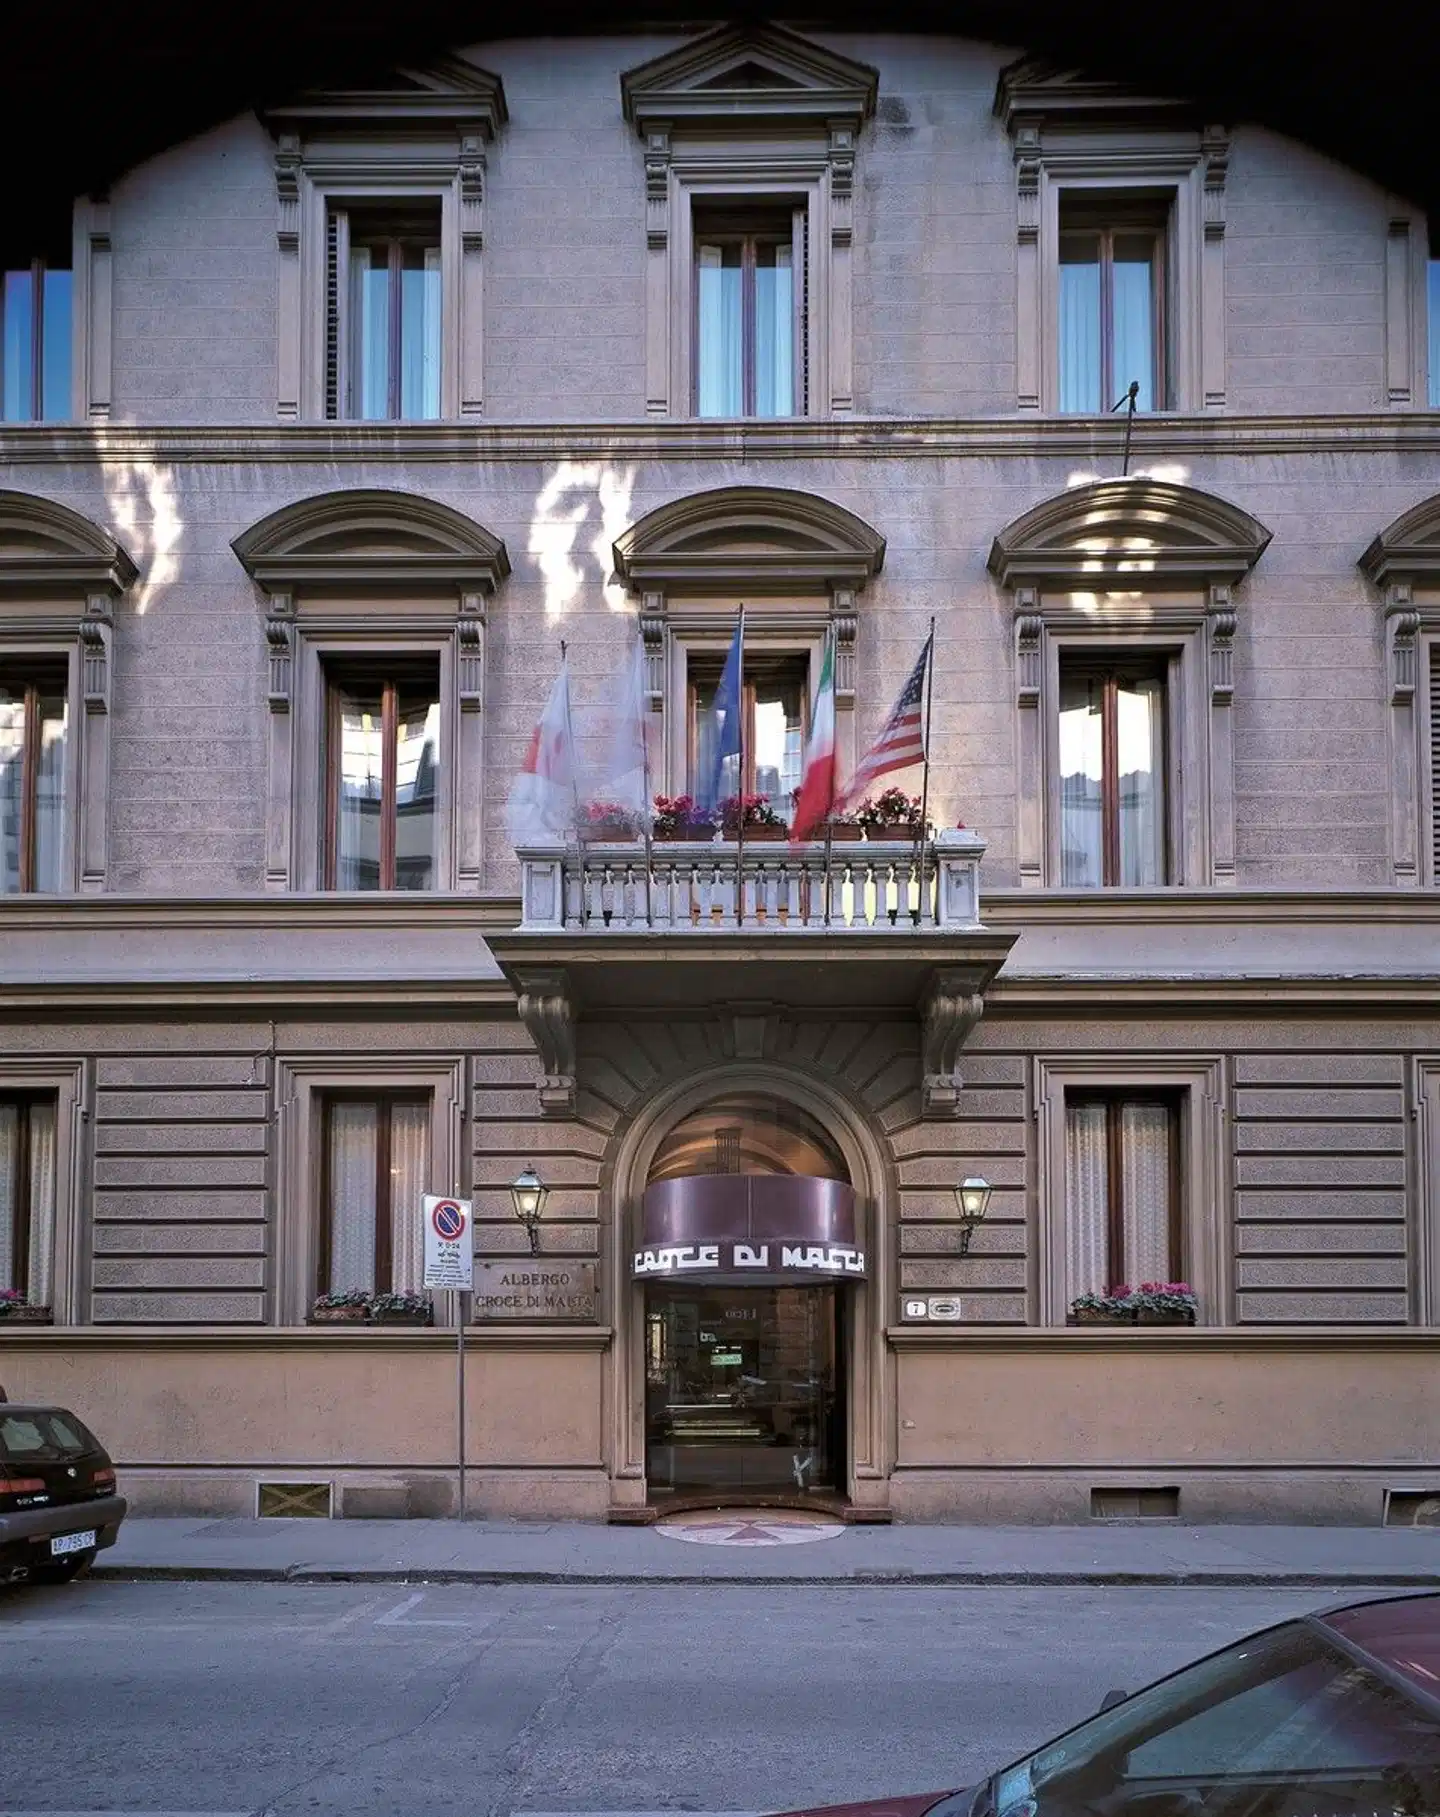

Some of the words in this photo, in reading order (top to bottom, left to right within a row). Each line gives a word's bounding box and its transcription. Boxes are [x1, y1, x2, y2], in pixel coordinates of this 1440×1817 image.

[733, 1246, 769, 1267] DI
[500, 1273, 570, 1286] ALBERGO
[476, 1295, 523, 1308] CROCE
[526, 1296, 540, 1308] DI
[912, 1303, 919, 1314] 7
